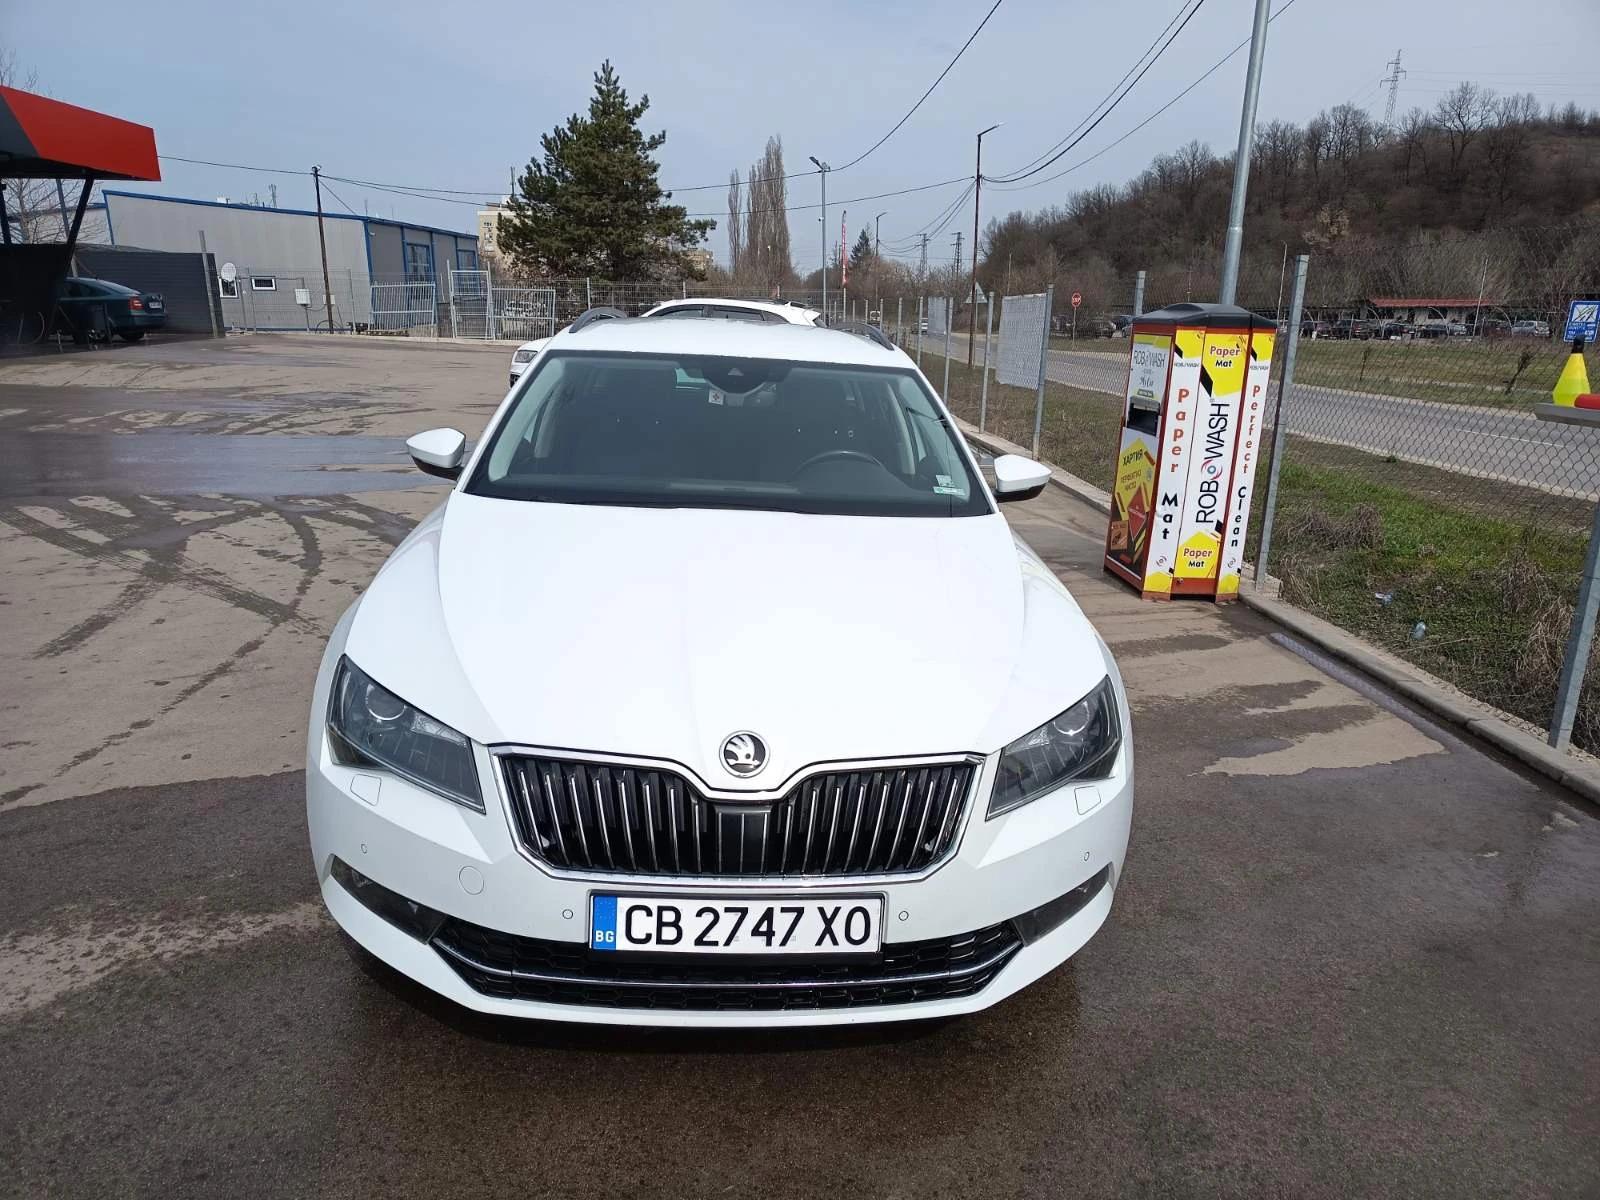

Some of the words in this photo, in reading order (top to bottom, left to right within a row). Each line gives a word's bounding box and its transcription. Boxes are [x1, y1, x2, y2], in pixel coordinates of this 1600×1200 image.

[1210, 346, 1240, 358] Paper
[1215, 360, 1233, 368] Mat
[1161, 493, 1179, 540] Mat
[1183, 548, 1212, 558] Paper
[625, 904, 683, 945] CB
[694, 906, 805, 947] 2747
[814, 906, 871, 946] XO
[595, 931, 614, 943] BG
